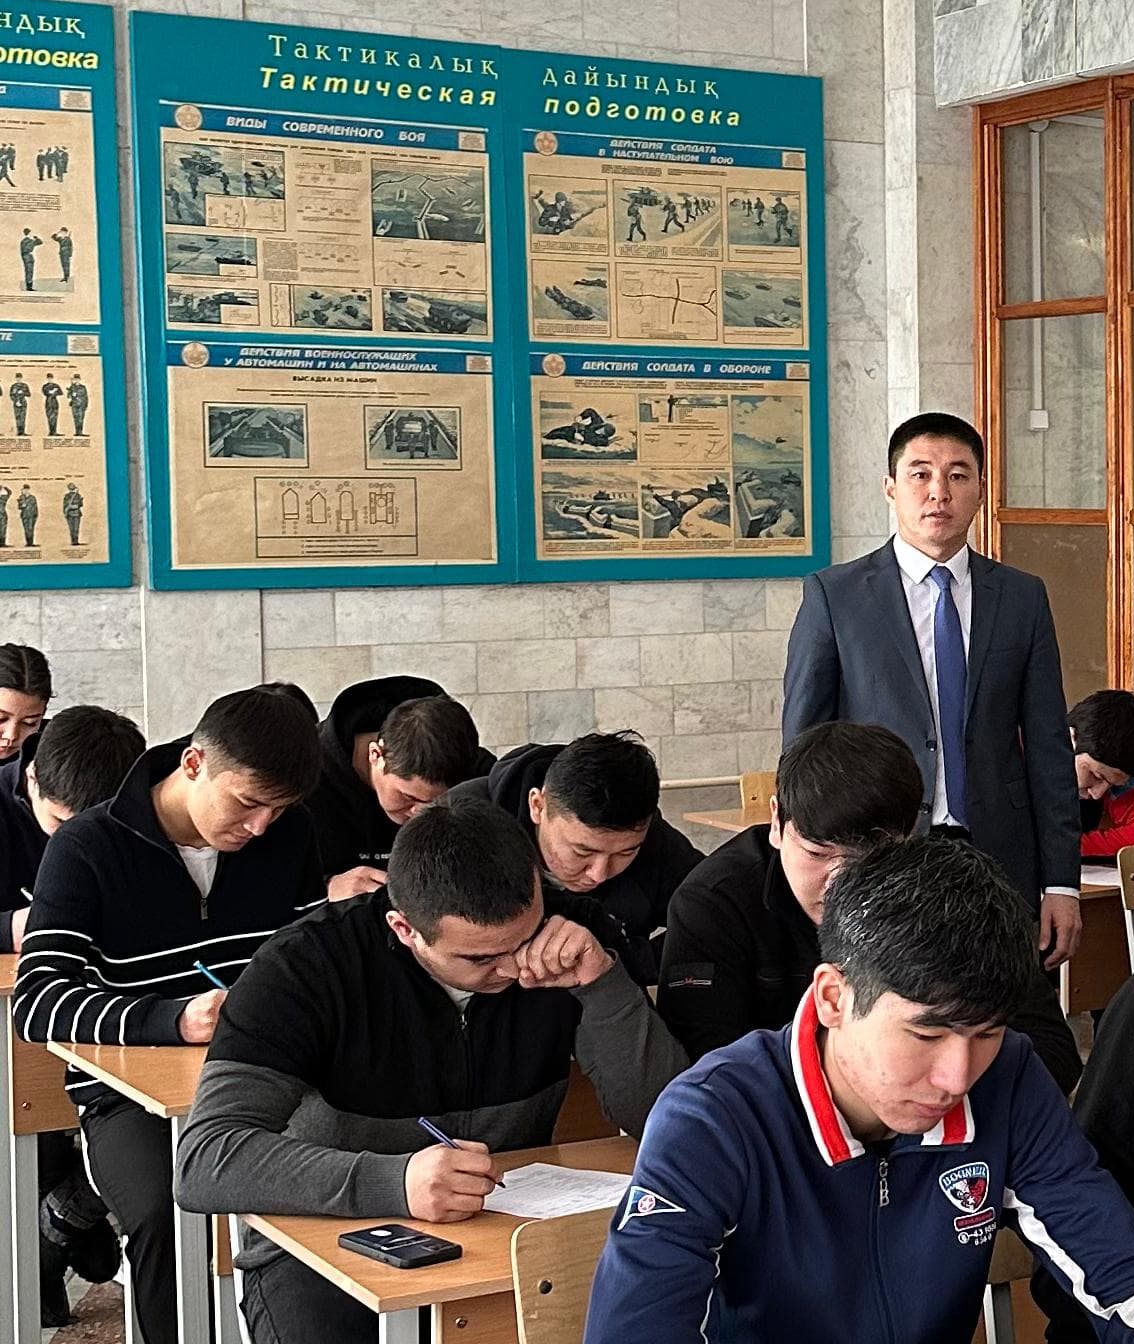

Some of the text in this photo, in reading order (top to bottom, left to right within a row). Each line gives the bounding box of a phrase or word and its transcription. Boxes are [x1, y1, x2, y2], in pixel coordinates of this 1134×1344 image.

[268, 34, 719, 99] Тактикалық дайындық
[260, 67, 740, 126] Тактическая подготовка
[226, 116, 426, 143] ВИДЫ СОВРЕМЕННОГО БОЯ
[671, 143, 717, 154] СОЛДАТА
[646, 362, 696, 373] СОЛДАТА
[719, 364, 772, 374] ОБОРОНЕ
